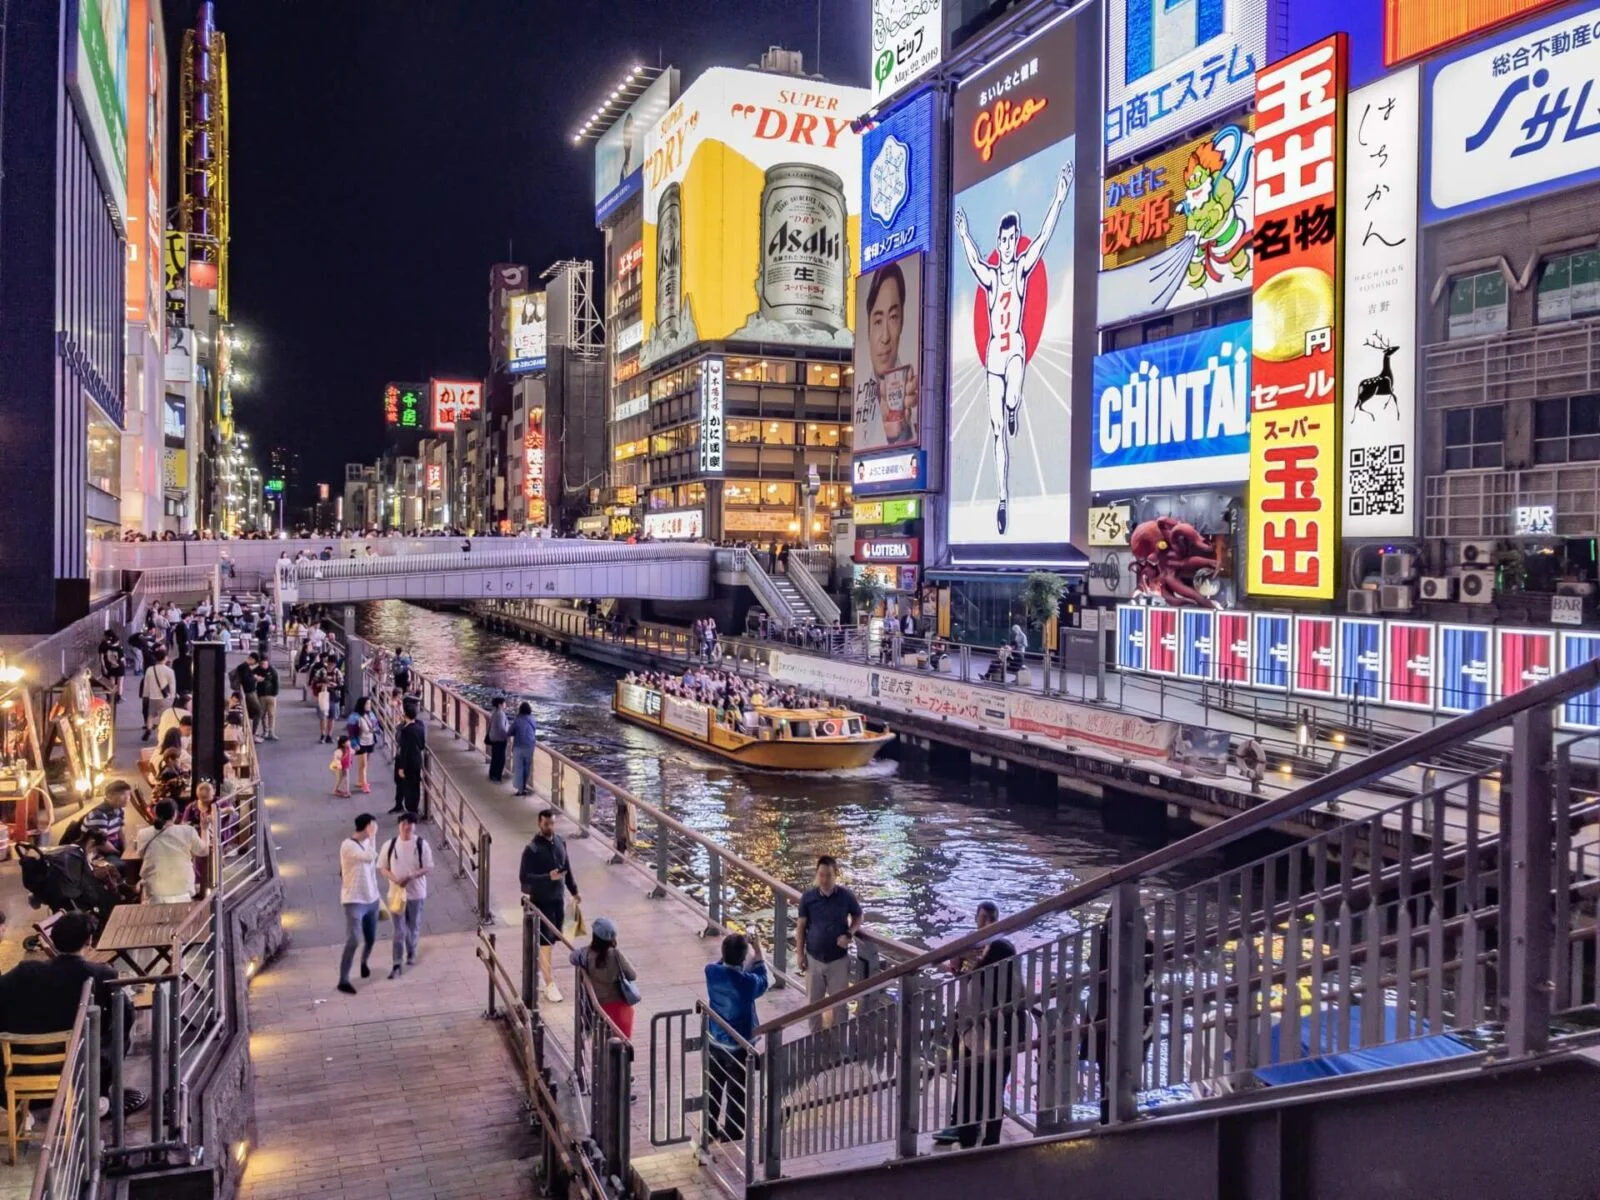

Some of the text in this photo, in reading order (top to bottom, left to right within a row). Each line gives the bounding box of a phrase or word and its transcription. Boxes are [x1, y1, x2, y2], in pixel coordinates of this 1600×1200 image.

[896, 26, 925, 66] ピップ
[777, 89, 839, 111] SUPER
[979, 57, 1039, 107] おいしさと健康
[1104, 44, 1256, 144] 日商エステム
[972, 96, 1048, 164] Glico
[1256, 45, 1335, 216] 玉出
[1106, 166, 1168, 206] かぜに
[1357, 97, 1407, 249] はちかん
[768, 219, 840, 262] Asahi
[1099, 191, 1172, 256] 改源
[1251, 204, 1337, 261] 名物
[794, 266, 815, 282] 生
[999, 290, 1012, 353] グリコ
[1305, 327, 1332, 356] 円
[440, 387, 475, 405] かに
[1252, 369, 1335, 412] セール
[1264, 414, 1320, 441] スーパー
[1096, 511, 1122, 540] くくる
[1261, 444, 1322, 587] 玉出
[1515, 506, 1553, 527] BAR
[871, 543, 908, 557] LOTTERIA
[486, 579, 556, 592] えびす橋
[1552, 598, 1582, 612] BAR
[880, 674, 914, 696] 近畿大学
[913, 695, 980, 720] オープンキャンパス
